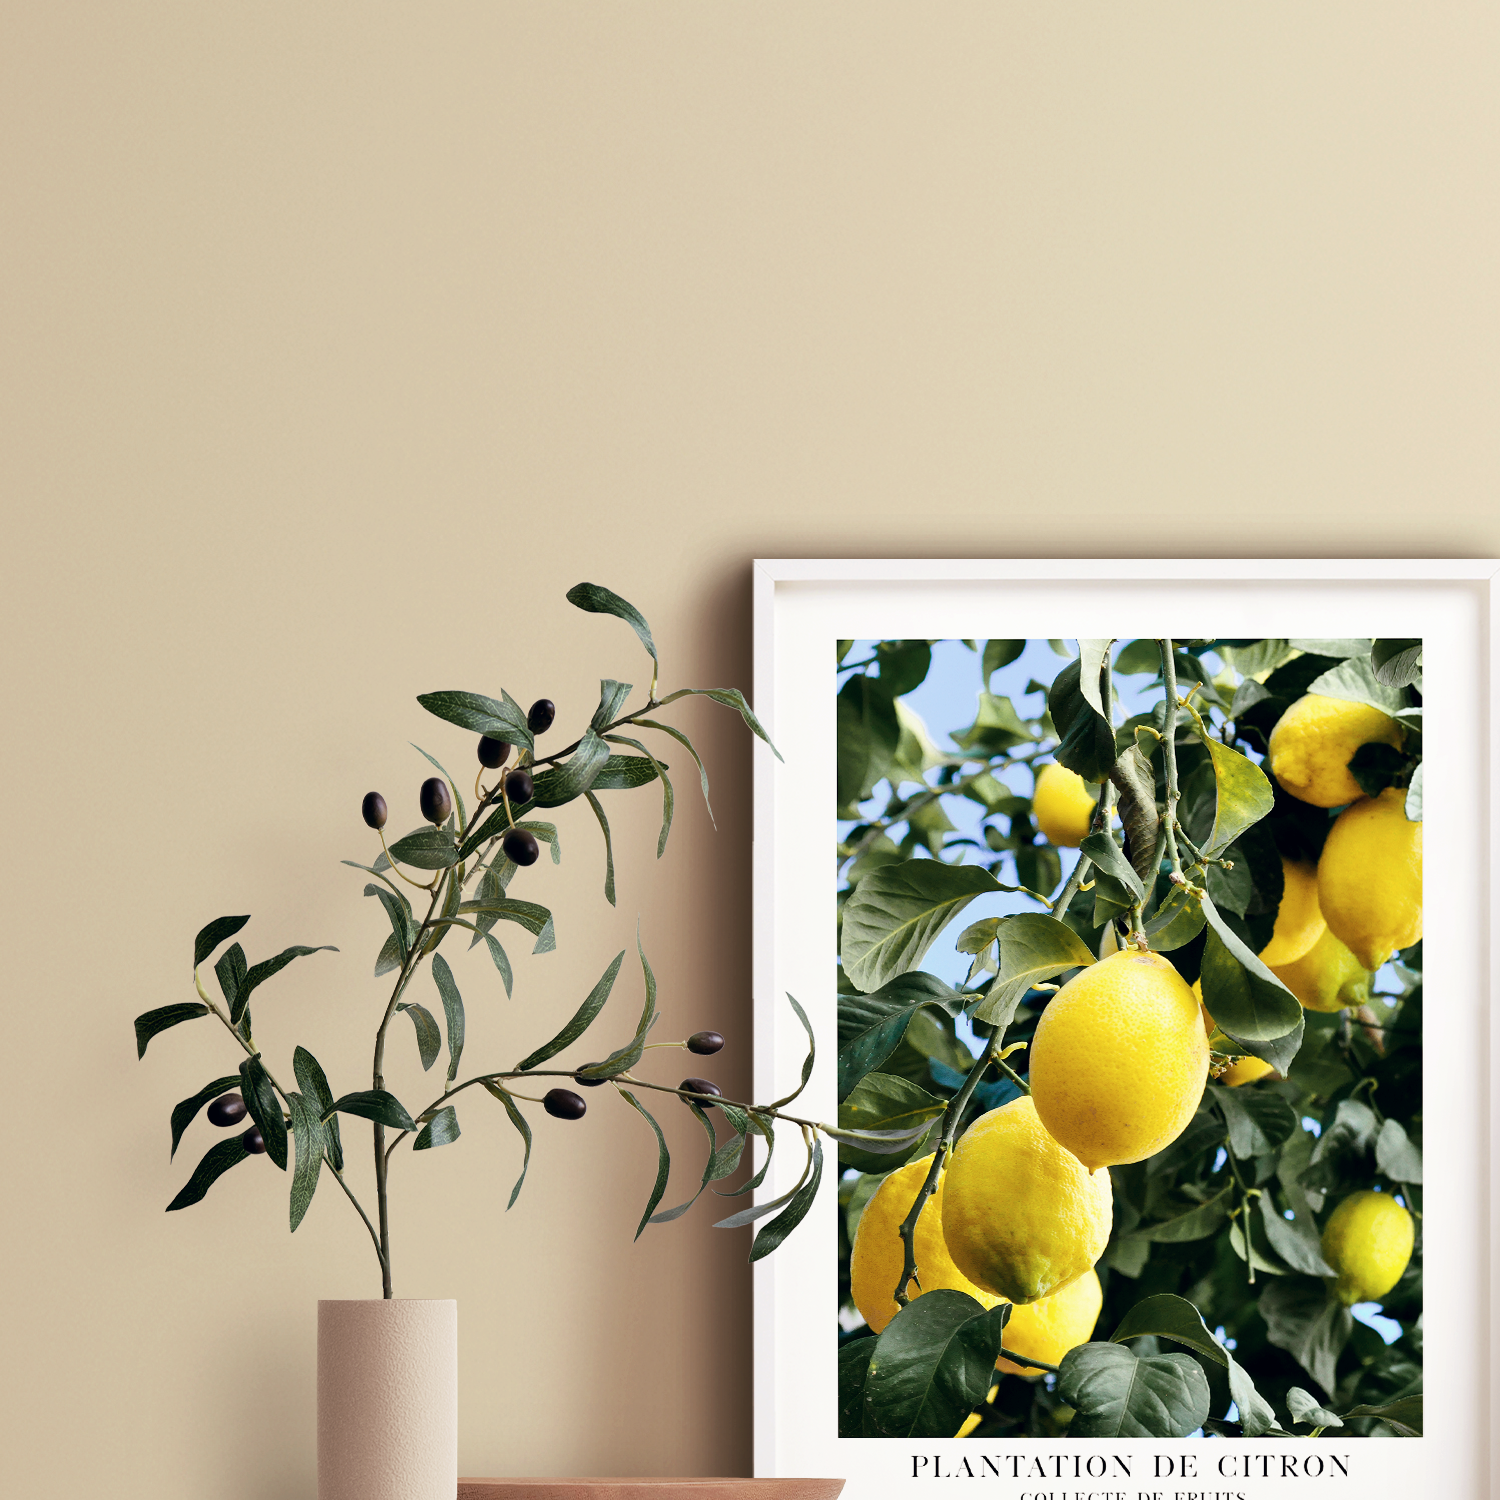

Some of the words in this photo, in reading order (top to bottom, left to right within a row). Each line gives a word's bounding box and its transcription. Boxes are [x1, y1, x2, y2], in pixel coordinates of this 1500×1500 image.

[910, 1454, 1133, 1478] PLANTATION
[1153, 1454, 1199, 1478] DE
[1217, 1454, 1351, 1478] CITRON
